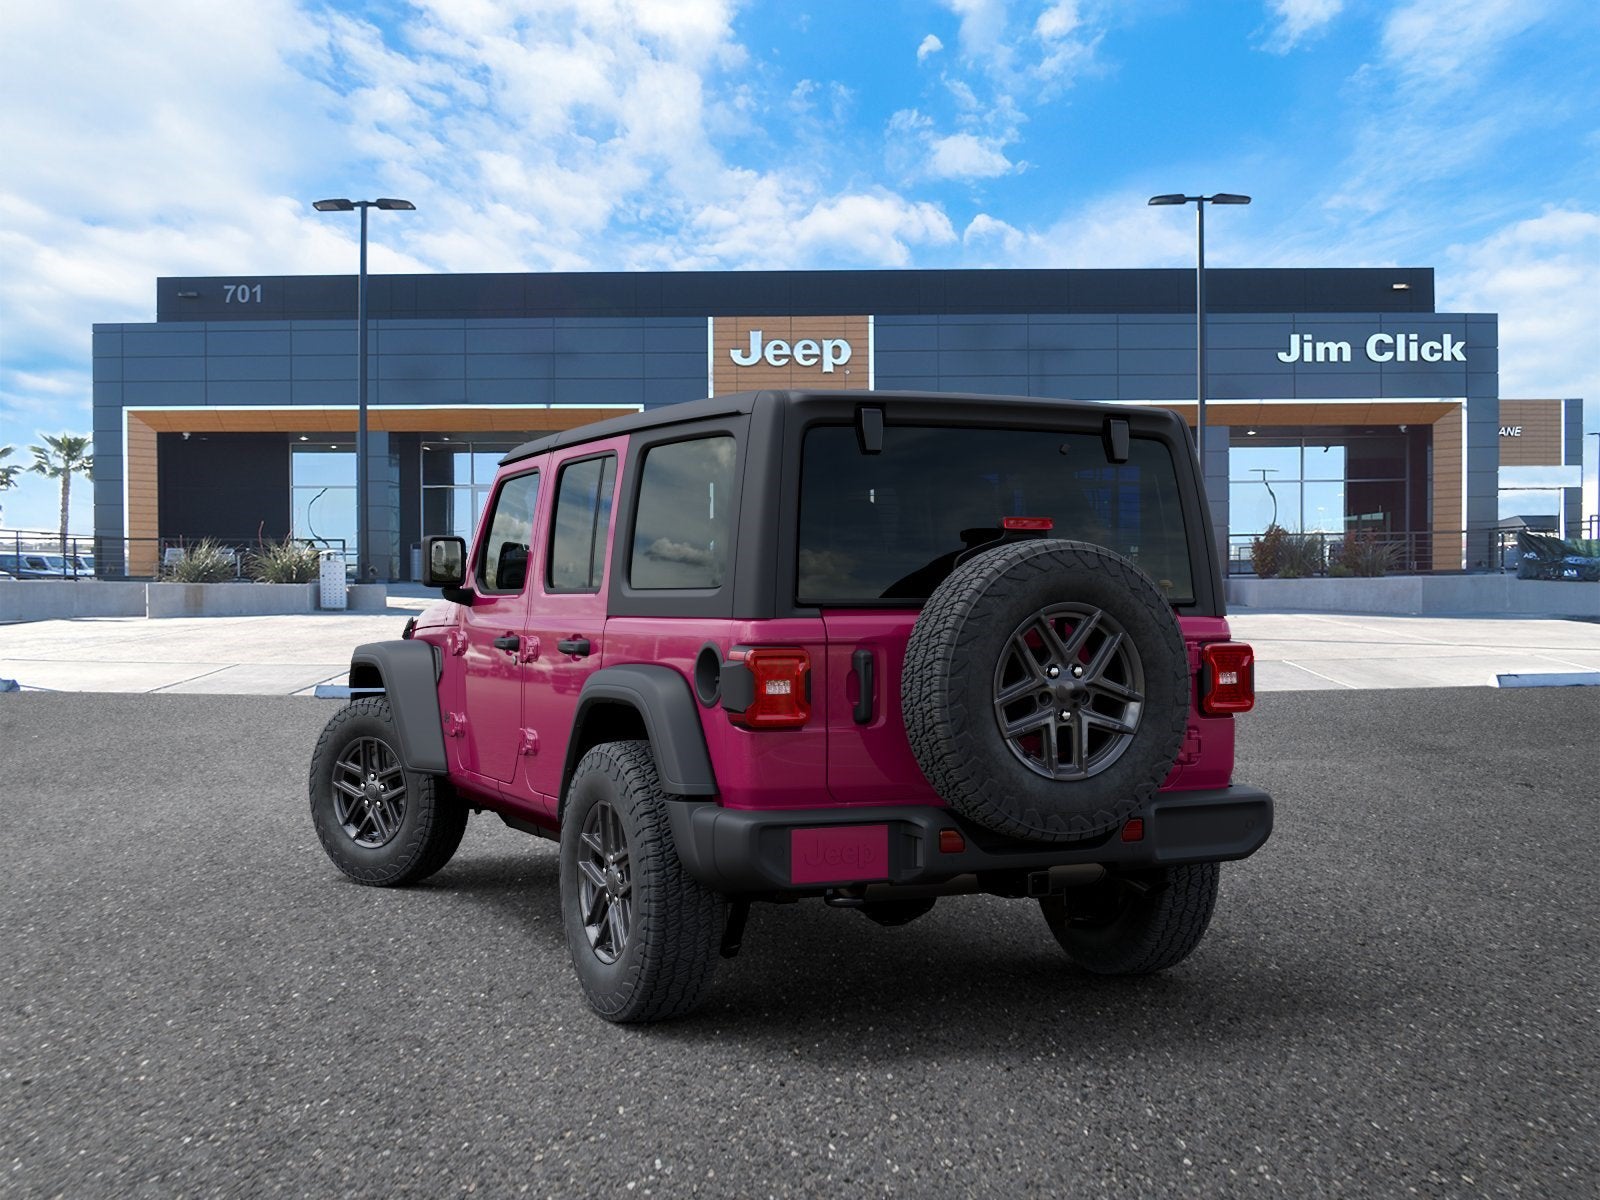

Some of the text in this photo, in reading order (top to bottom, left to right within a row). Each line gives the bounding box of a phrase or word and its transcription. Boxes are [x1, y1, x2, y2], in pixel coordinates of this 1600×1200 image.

[223, 284, 262, 304] 701
[730, 330, 852, 374] Jeep
[1277, 333, 1467, 363] Jim Click
[802, 839, 876, 870] Jeep
